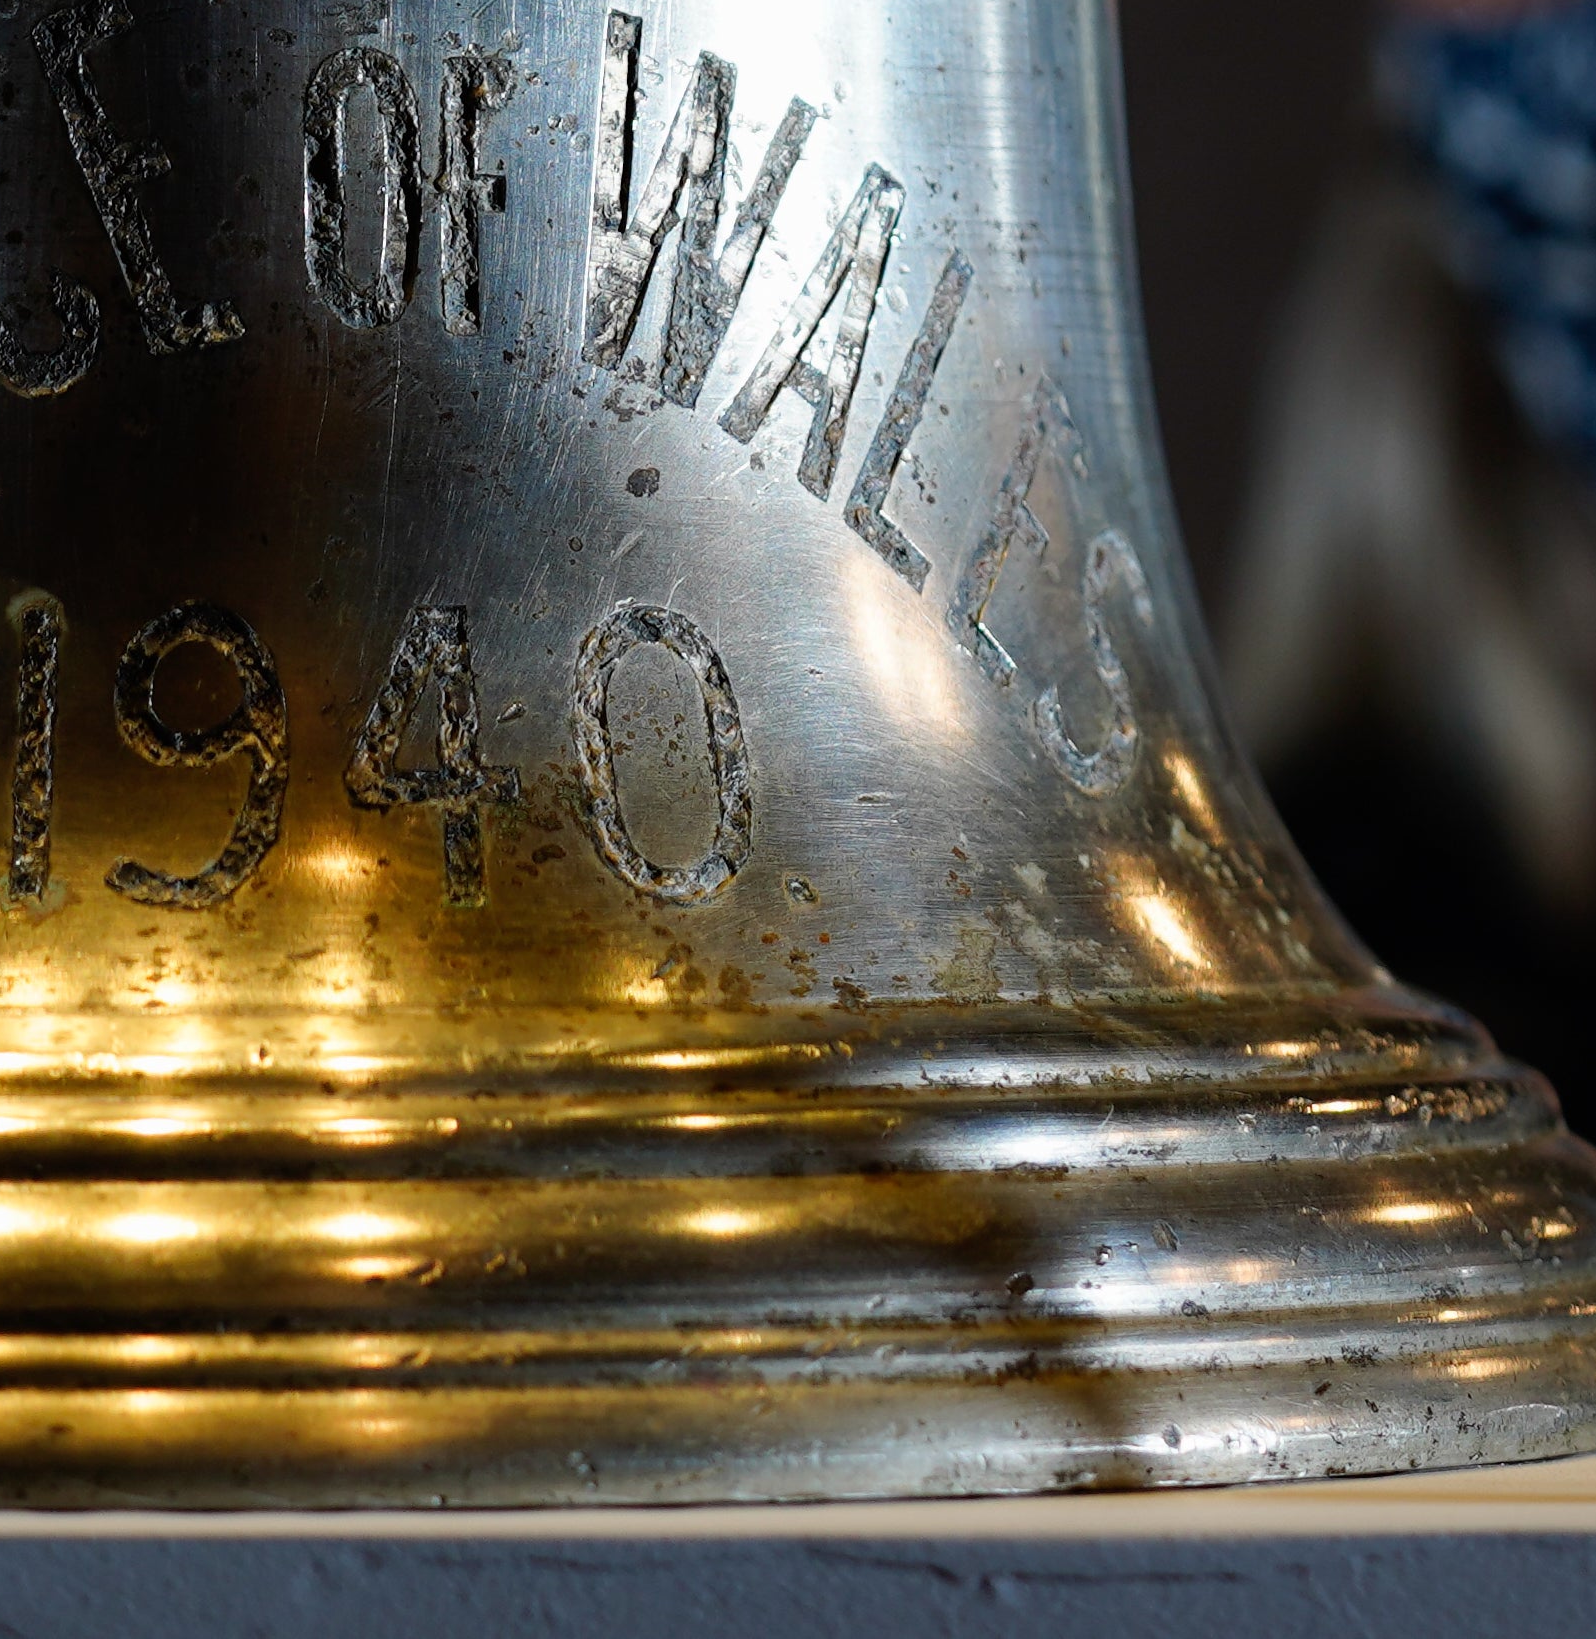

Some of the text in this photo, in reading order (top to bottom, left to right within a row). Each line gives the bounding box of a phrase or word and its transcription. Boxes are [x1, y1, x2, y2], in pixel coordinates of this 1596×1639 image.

[302, 46, 517, 337] OF
[581, 8, 1153, 798] WALES
[8, 593, 753, 909] 1940
